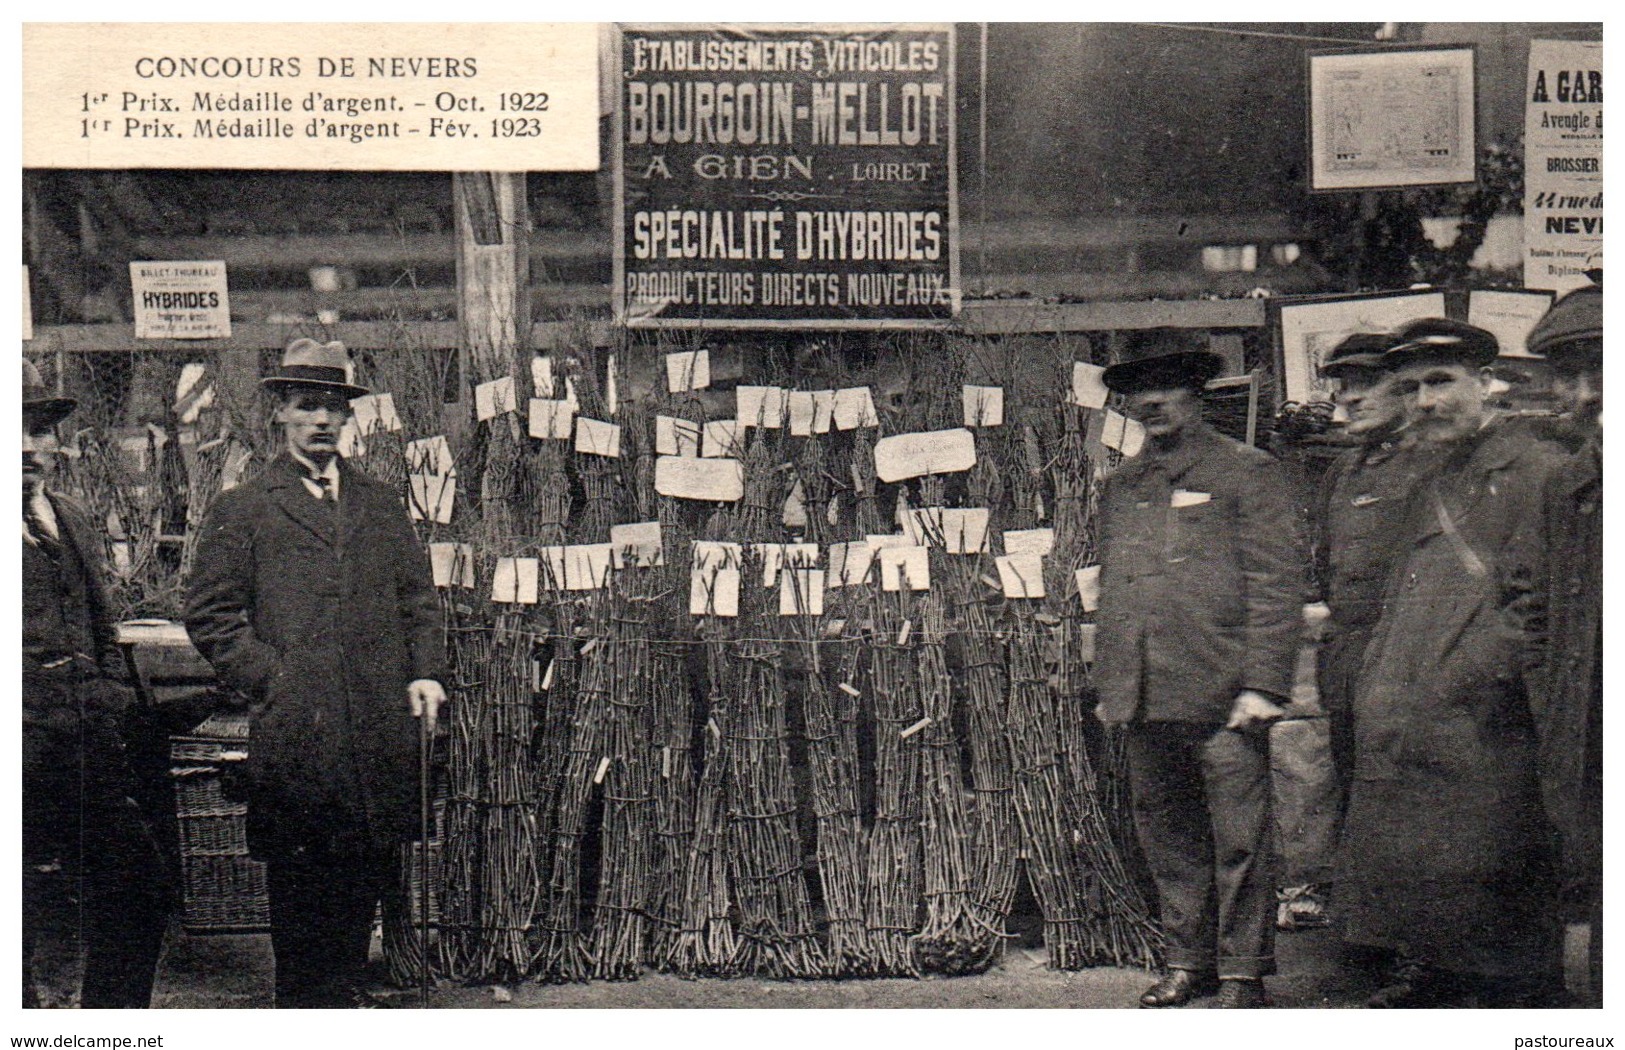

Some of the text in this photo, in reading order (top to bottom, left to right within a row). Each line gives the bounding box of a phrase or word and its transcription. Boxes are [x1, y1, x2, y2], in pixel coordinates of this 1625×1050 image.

[813, 36, 939, 78] VITICOLES
[1532, 70, 1551, 103] A
[629, 81, 943, 146] BOURGOIN-MELLOT
[1541, 111, 1590, 132] Aveugle
[643, 154, 931, 182] A GIEN LOIRET
[1547, 157, 1599, 173] BROSSIER
[634, 205, 941, 260] SPÉCIALITÉ D'HYBRIDES
[1546, 216, 1603, 234] NEV
[143, 290, 219, 309] HYBRIDES
[627, 271, 947, 305] PRODUCTEURS DIRECTS NOUVEAUX
